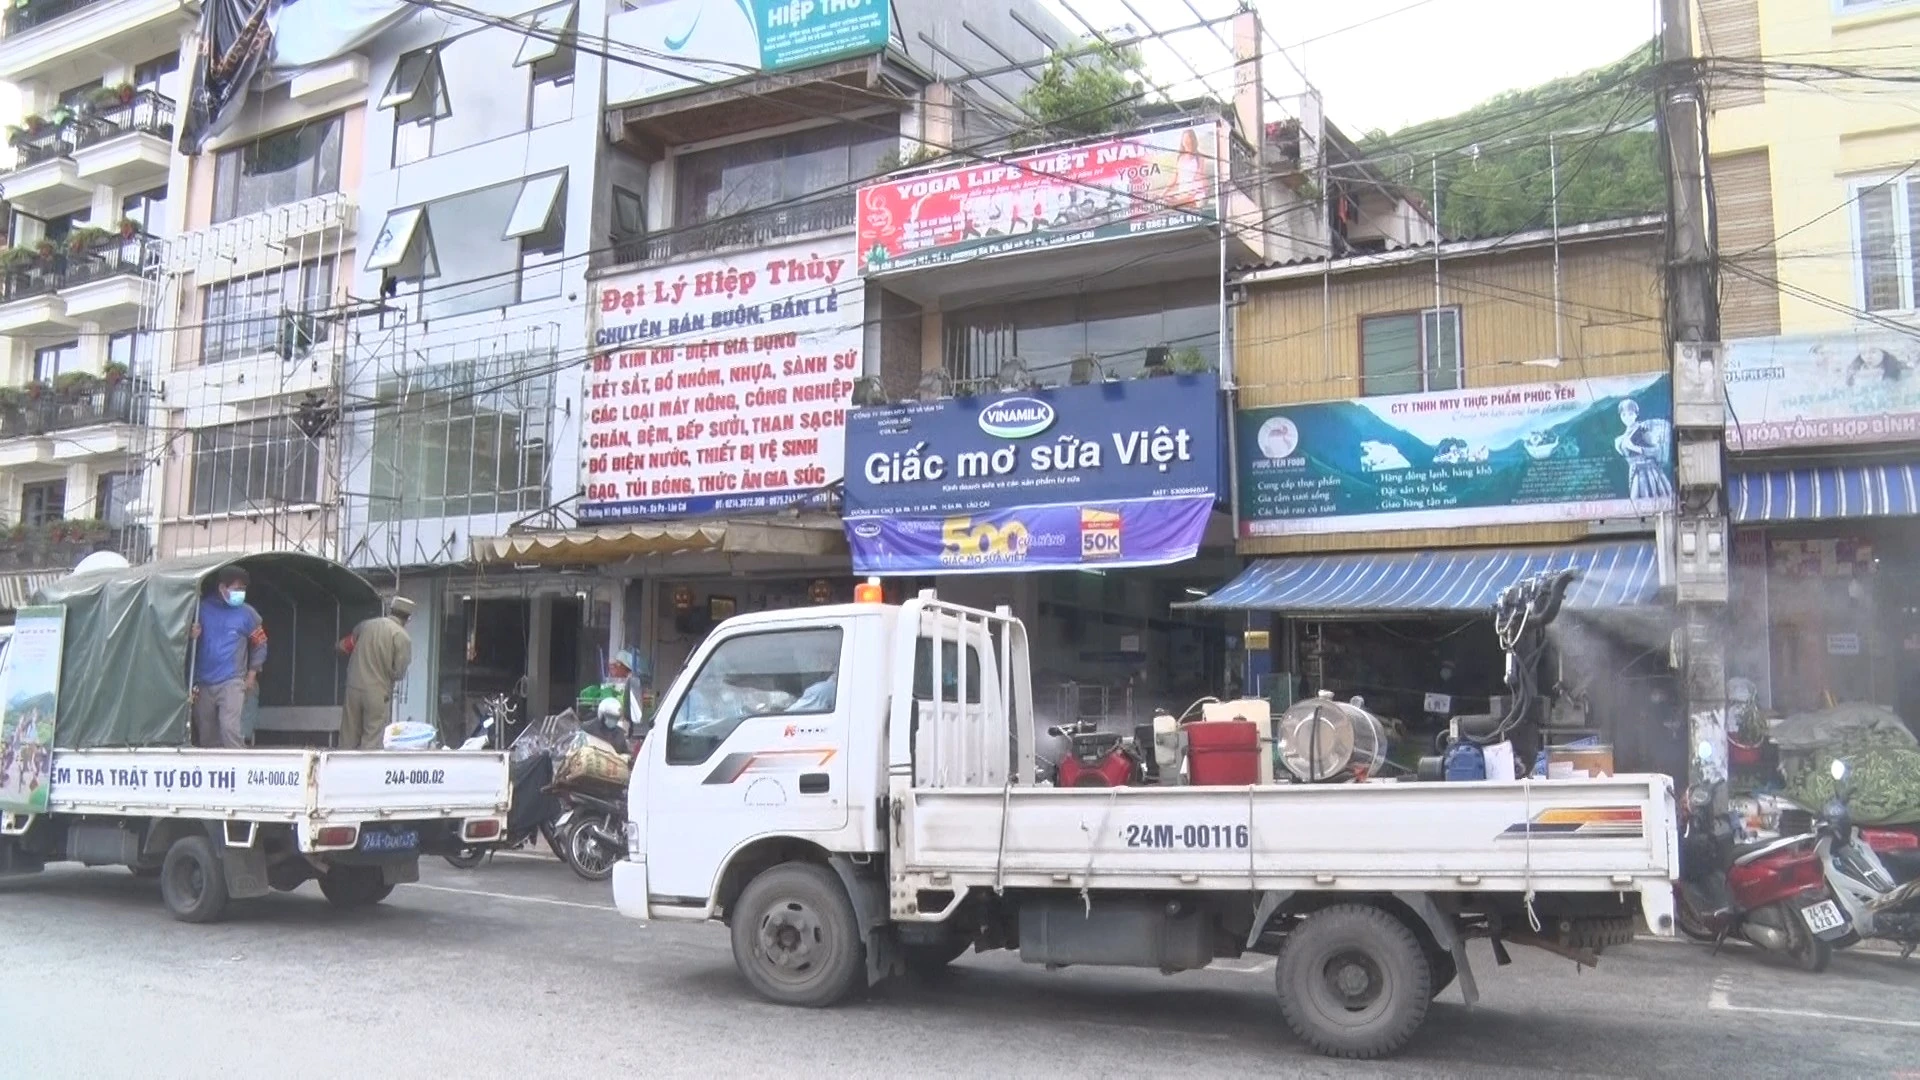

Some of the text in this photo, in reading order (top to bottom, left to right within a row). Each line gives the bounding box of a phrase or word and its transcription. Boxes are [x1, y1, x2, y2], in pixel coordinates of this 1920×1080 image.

[897, 176, 961, 199] YOGA
[967, 165, 1023, 187] LIFE
[1028, 152, 1089, 174] VIỆT
[1118, 162, 1161, 181] YOGA
[601, 284, 645, 315] Đại
[654, 275, 688, 304] Lý
[694, 267, 756, 299] Hiệp
[595, 318, 662, 346] CHUYÊN
[669, 312, 704, 335] BÁN
[711, 304, 764, 328] BUÔN,
[771, 296, 809, 320] BÁN
[620, 351, 646, 369] KIM
[724, 337, 748, 355] GIA
[754, 331, 797, 355] DỤNG
[678, 367, 725, 389] NHÔM,
[730, 363, 776, 384] NHỰA,
[783, 355, 827, 376] SÀNH
[591, 378, 853, 424] CÁC LOẠI MÁY NÔNG, CÔNG NGHIỆP
[1391, 402, 1408, 414] CTY
[1412, 400, 1436, 412] TNHH
[1440, 398, 1460, 410] MTV
[1464, 394, 1488, 410] THỰC
[1491, 389, 1521, 406] PHẨM
[1524, 388, 1551, 404] PHÚC
[1553, 385, 1575, 400] YÊN
[590, 428, 632, 449] CHĂN,
[677, 419, 704, 440] BẾP
[752, 414, 794, 434] THAN
[800, 409, 844, 432] SẠCH
[987, 406, 1047, 424] VINAMILK
[1746, 421, 1781, 442] HÓA
[1783, 414, 1828, 439] TỔNG
[1832, 423, 1868, 438] HỢP
[1872, 412, 1916, 434] BÌNH
[612, 452, 645, 475] ĐIỆN
[649, 446, 691, 468] NƯỚC,
[697, 440, 736, 464] THIẾT
[740, 443, 754, 464] BỊ
[760, 439, 777, 462] VỆ
[782, 438, 818, 457] SINH
[864, 425, 1191, 485] Giấc mơ sữa Việt
[588, 482, 619, 503] GẠO,
[698, 471, 737, 492] THỨC
[741, 468, 762, 490] ĂN
[764, 470, 789, 488] GIA
[794, 463, 825, 485] SÚC
[1257, 480, 1279, 491] Cung
[1317, 475, 1341, 488] phẩm
[1381, 472, 1403, 484] Hàng
[1405, 470, 1427, 482] đông
[1452, 467, 1474, 479] hàng
[1258, 493, 1272, 503] Gia
[1381, 499, 1401, 510] Giao
[941, 516, 1029, 556] 500
[1083, 533, 1118, 551] 50K
[76, 768, 104, 786] TRA
[109, 766, 148, 790] TRẬT
[154, 768, 178, 792] TỰ
[179, 766, 202, 788] ĐÔ
[208, 767, 236, 793] THỊ
[247, 769, 300, 786] 24A-000.02
[384, 769, 445, 785] 24A-000.02
[1126, 824, 1249, 849] 24M-00116
